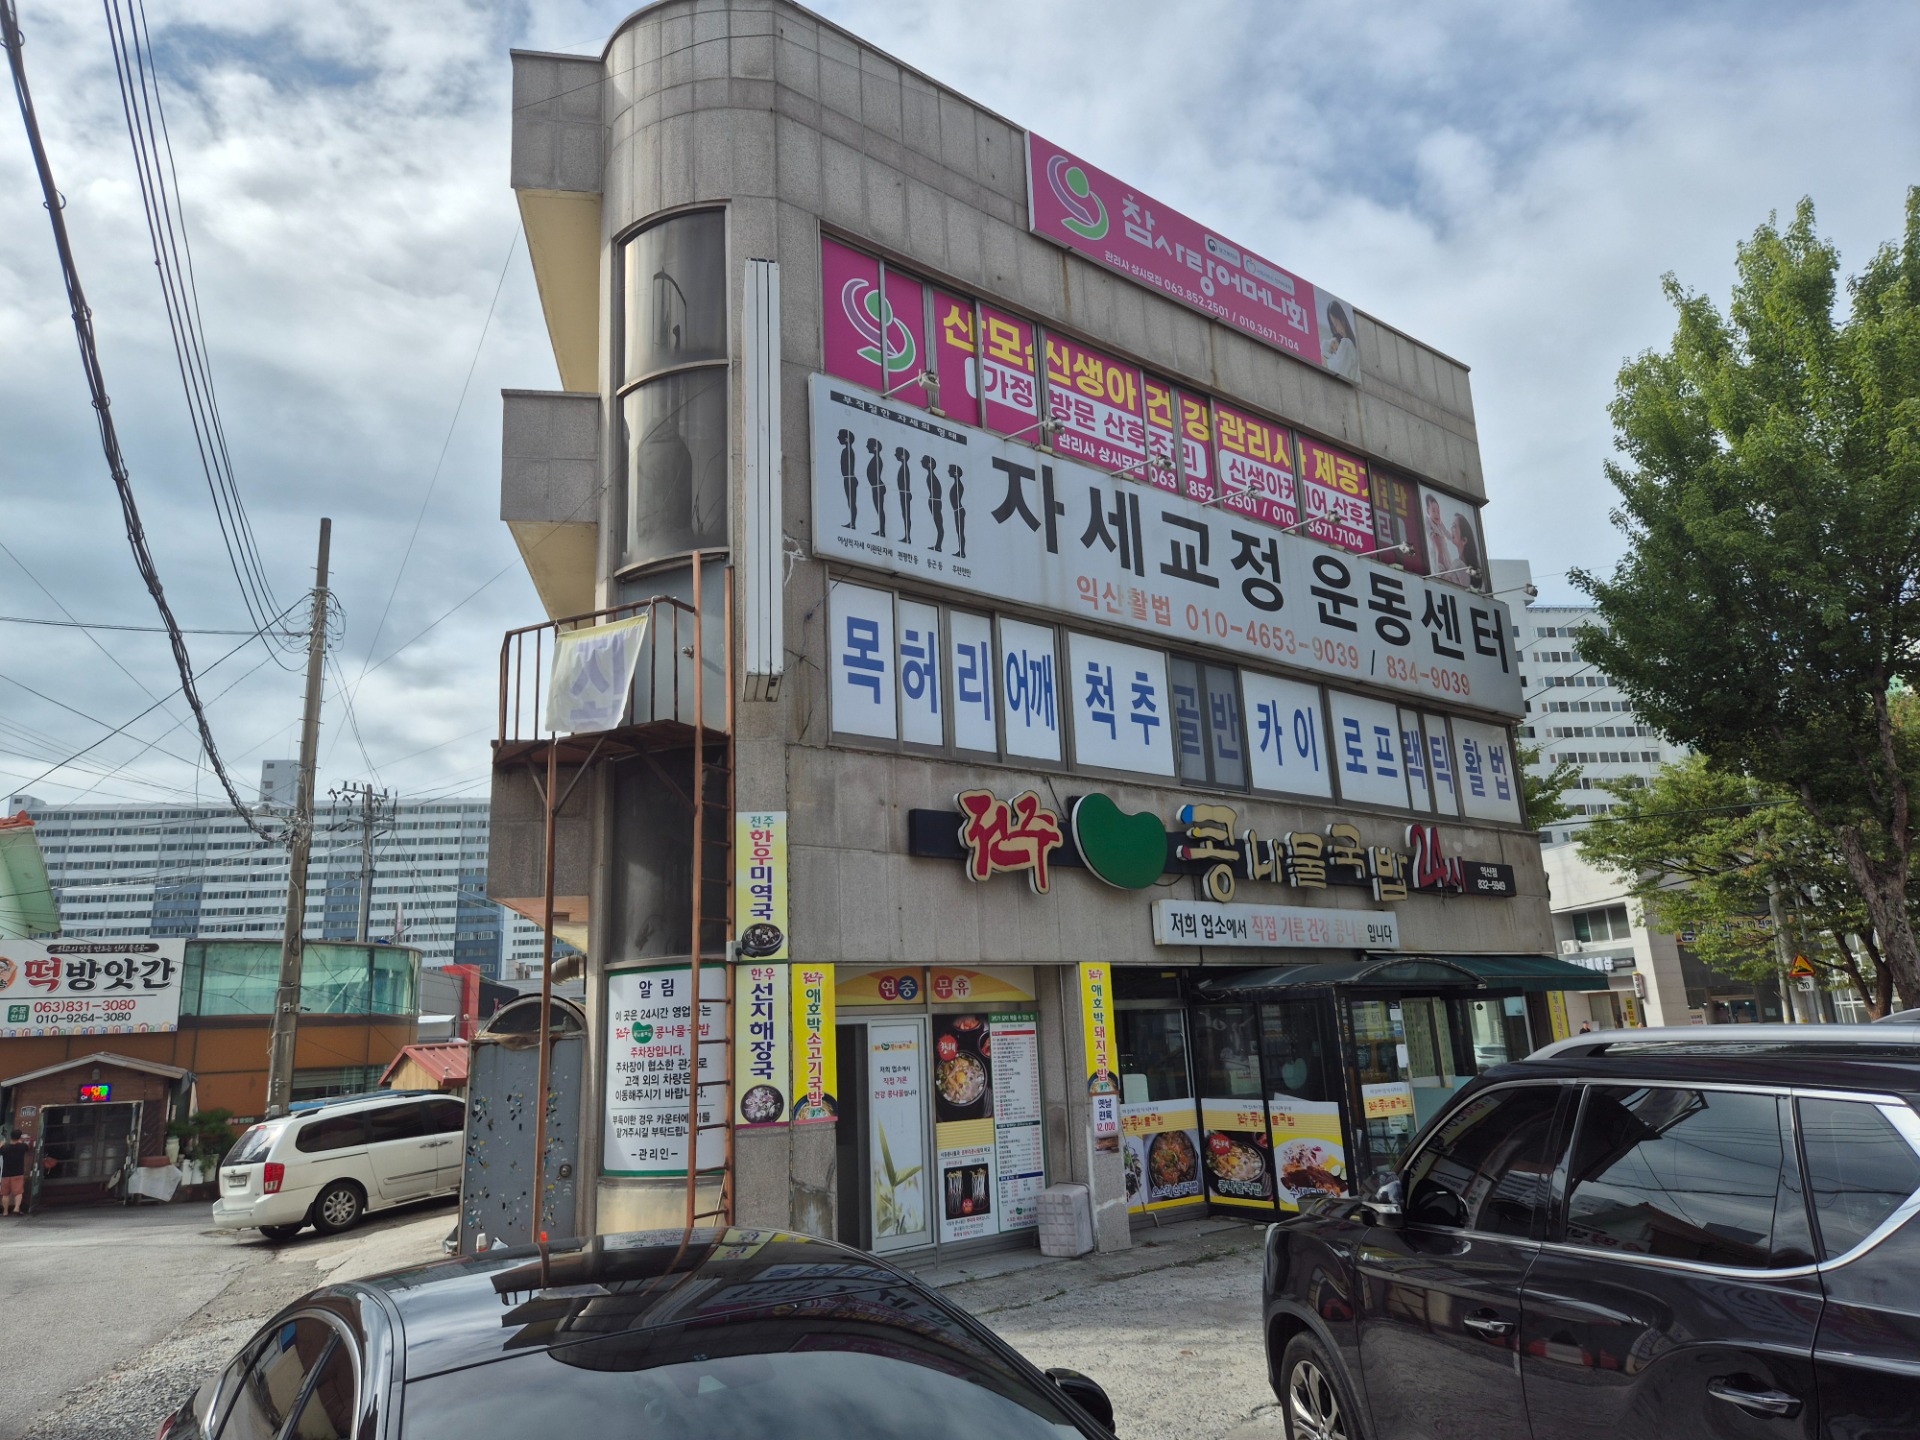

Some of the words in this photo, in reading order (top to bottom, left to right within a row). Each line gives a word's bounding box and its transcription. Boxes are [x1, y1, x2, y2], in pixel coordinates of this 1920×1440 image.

[1122, 194, 1309, 334] 참사랑어머니회
[1105, 250, 1129, 270] 관리사
[1131, 262, 1162, 287] 상시모집
[1164, 279, 1229, 317] 063.852.2501
[1239, 315, 1300, 352] 010.3671.7104
[984, 364, 1033, 408] 가정
[1050, 389, 1096, 432] 방문
[1058, 433, 1095, 458] 관리사
[1099, 447, 1145, 475] 상시모집
[991, 456, 1284, 612] 자세교정
[1310, 554, 1509, 674] 운동센터
[1076, 575, 1172, 627] 익산활법
[1186, 604, 1360, 669] 010-4653-9039
[1386, 655, 1471, 696] 834-9039
[842, 615, 884, 704] 목
[900, 629, 991, 722] 허리
[1006, 649, 1056, 732] 어깨
[1085, 661, 1161, 746] 척추
[1173, 684, 1239, 761] 골반
[1463, 737, 1511, 801] 활법
[750, 815, 775, 829] 전주
[957, 790, 1062, 893] 전주
[1177, 803, 1408, 902] 콩나물국밥
[1406, 824, 1468, 892] 24시
[750, 829, 775, 921] 한우미역국
[1170, 913, 1198, 938] 저희
[1201, 914, 1247, 939] 업소에서
[1251, 915, 1277, 941] 직접
[1367, 924, 1392, 943] 입니다
[25, 956, 176, 993] 떡방앗간
[751, 967, 775, 981] 한우
[1799, 982, 1810, 990] 30
[34, 1000, 136, 1014] 063)831-3080
[36, 1011, 131, 1024] 010-9264-3080
[640, 1007, 669, 1020] 24시간
[672, 1005, 711, 1018] 영업는
[750, 982, 775, 1080] 선지해장국
[630, 1044, 685, 1058] 주차장입니다.
[806, 988, 824, 1108] 애호박소고기국밥
[616, 1061, 645, 1073] 주차장이
[648, 1059, 674, 1072] 협소한
[625, 1075, 639, 1086] 고객
[642, 1074, 659, 1086] 외의
[615, 1088, 661, 1101] 이동해주시기
[639, 1113, 653, 1125] 경우
